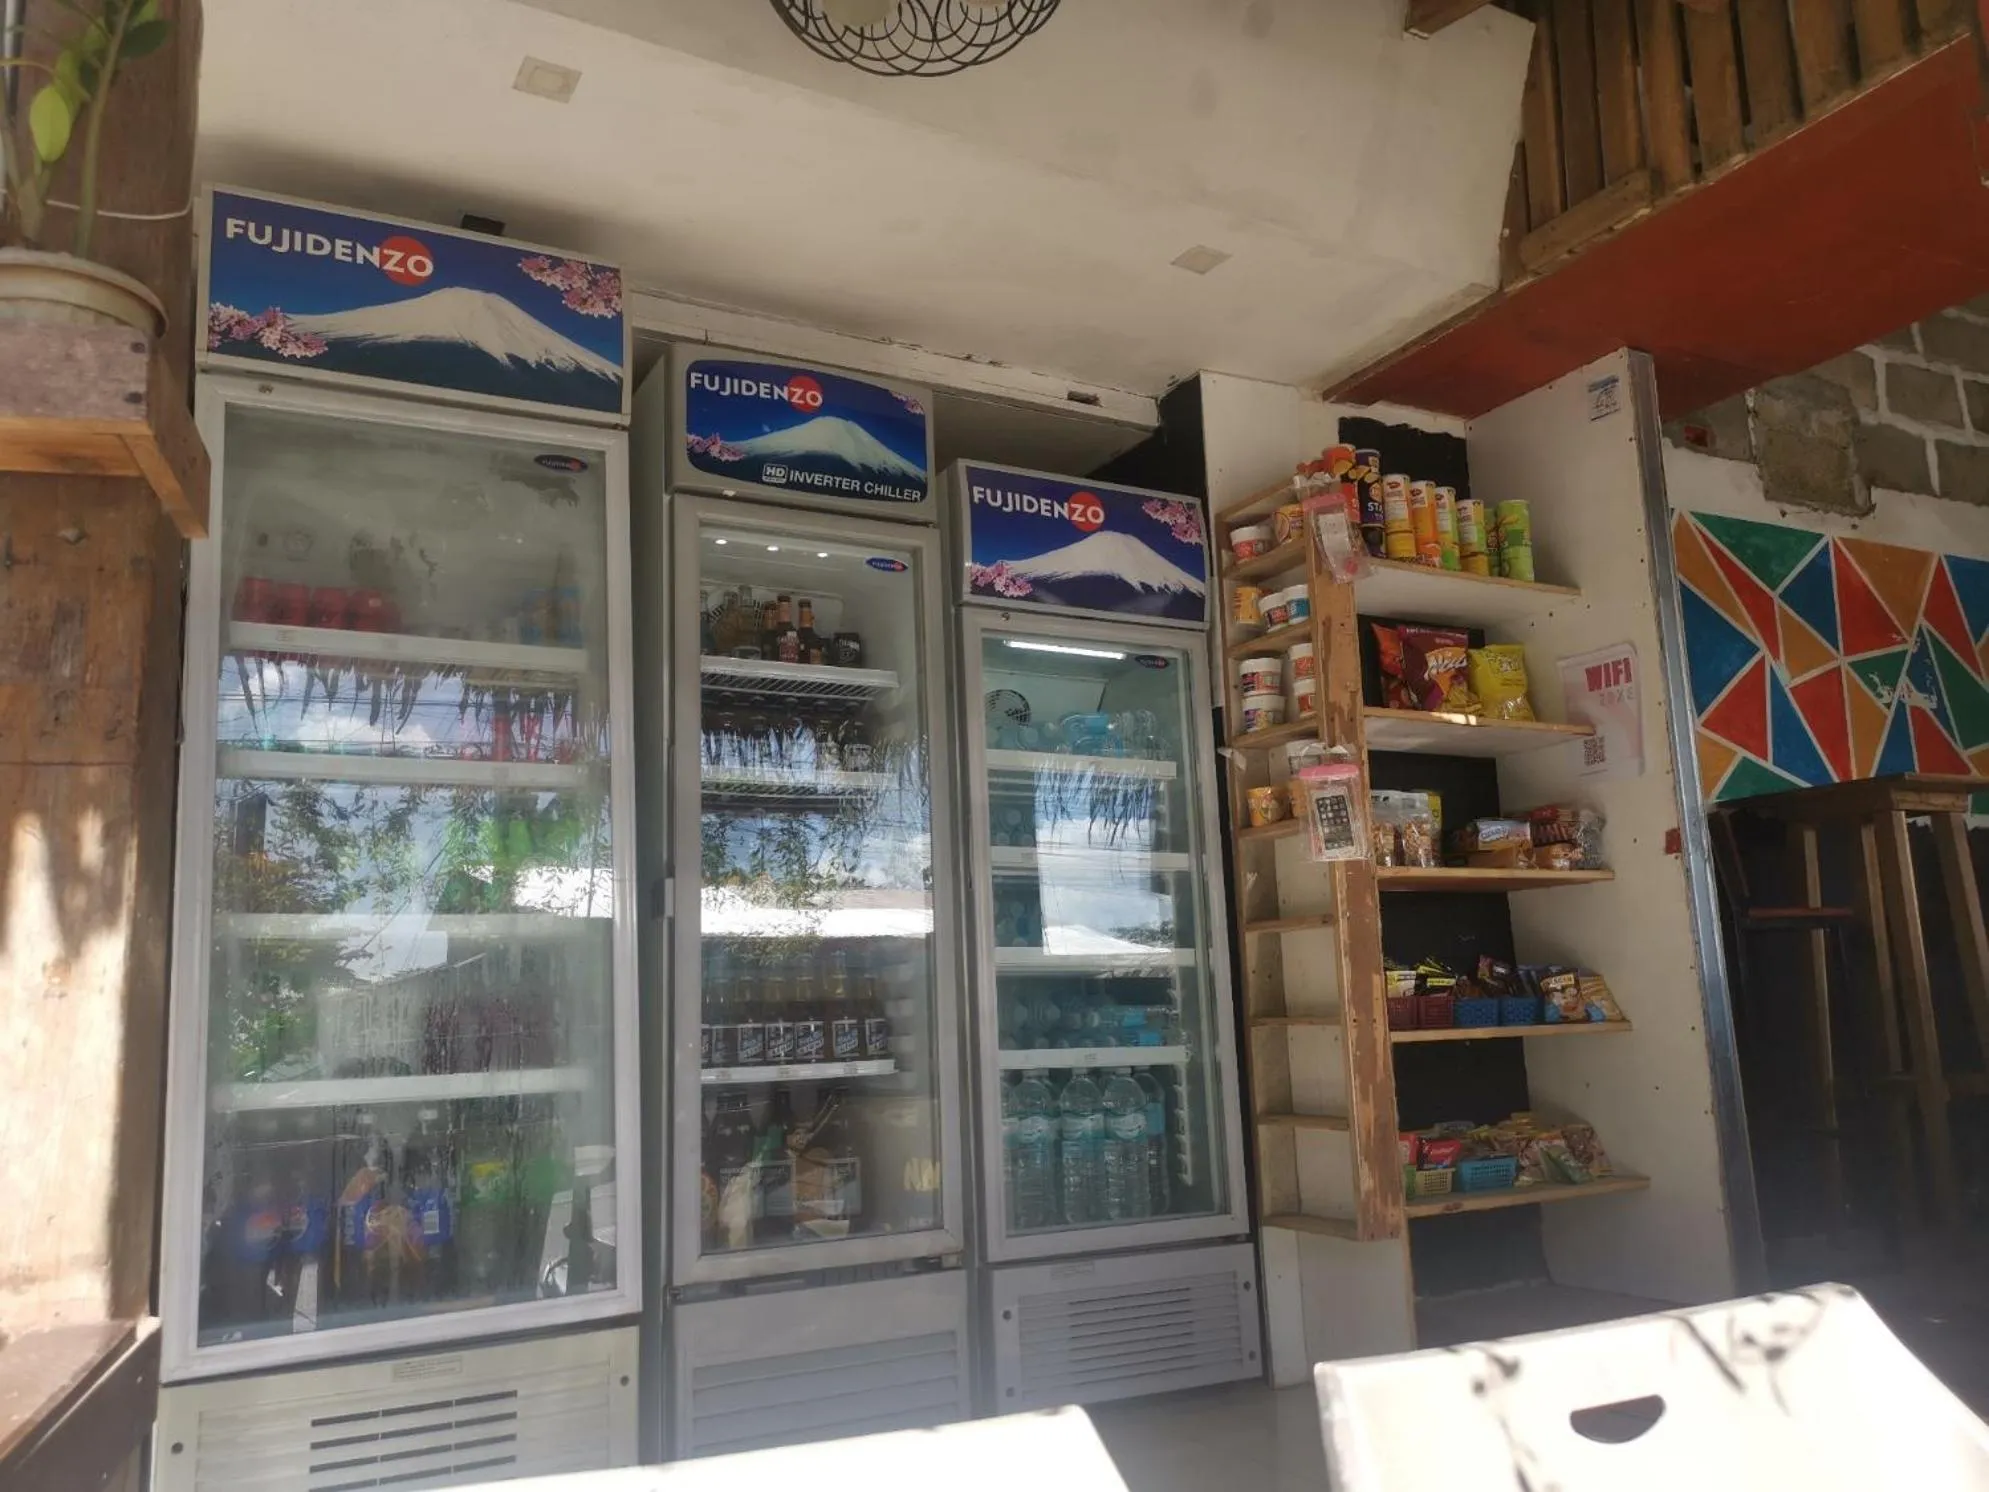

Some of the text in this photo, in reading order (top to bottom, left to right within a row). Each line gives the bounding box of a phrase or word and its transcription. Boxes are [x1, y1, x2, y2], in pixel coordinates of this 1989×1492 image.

[225, 217, 434, 278] FUJIDENZO
[690, 372, 823, 408] FUJIDENZO
[766, 466, 921, 501] HD INVERTER CHILLER
[972, 486, 1105, 524] FUJIDENZO
[1585, 656, 1632, 692] WIFI
